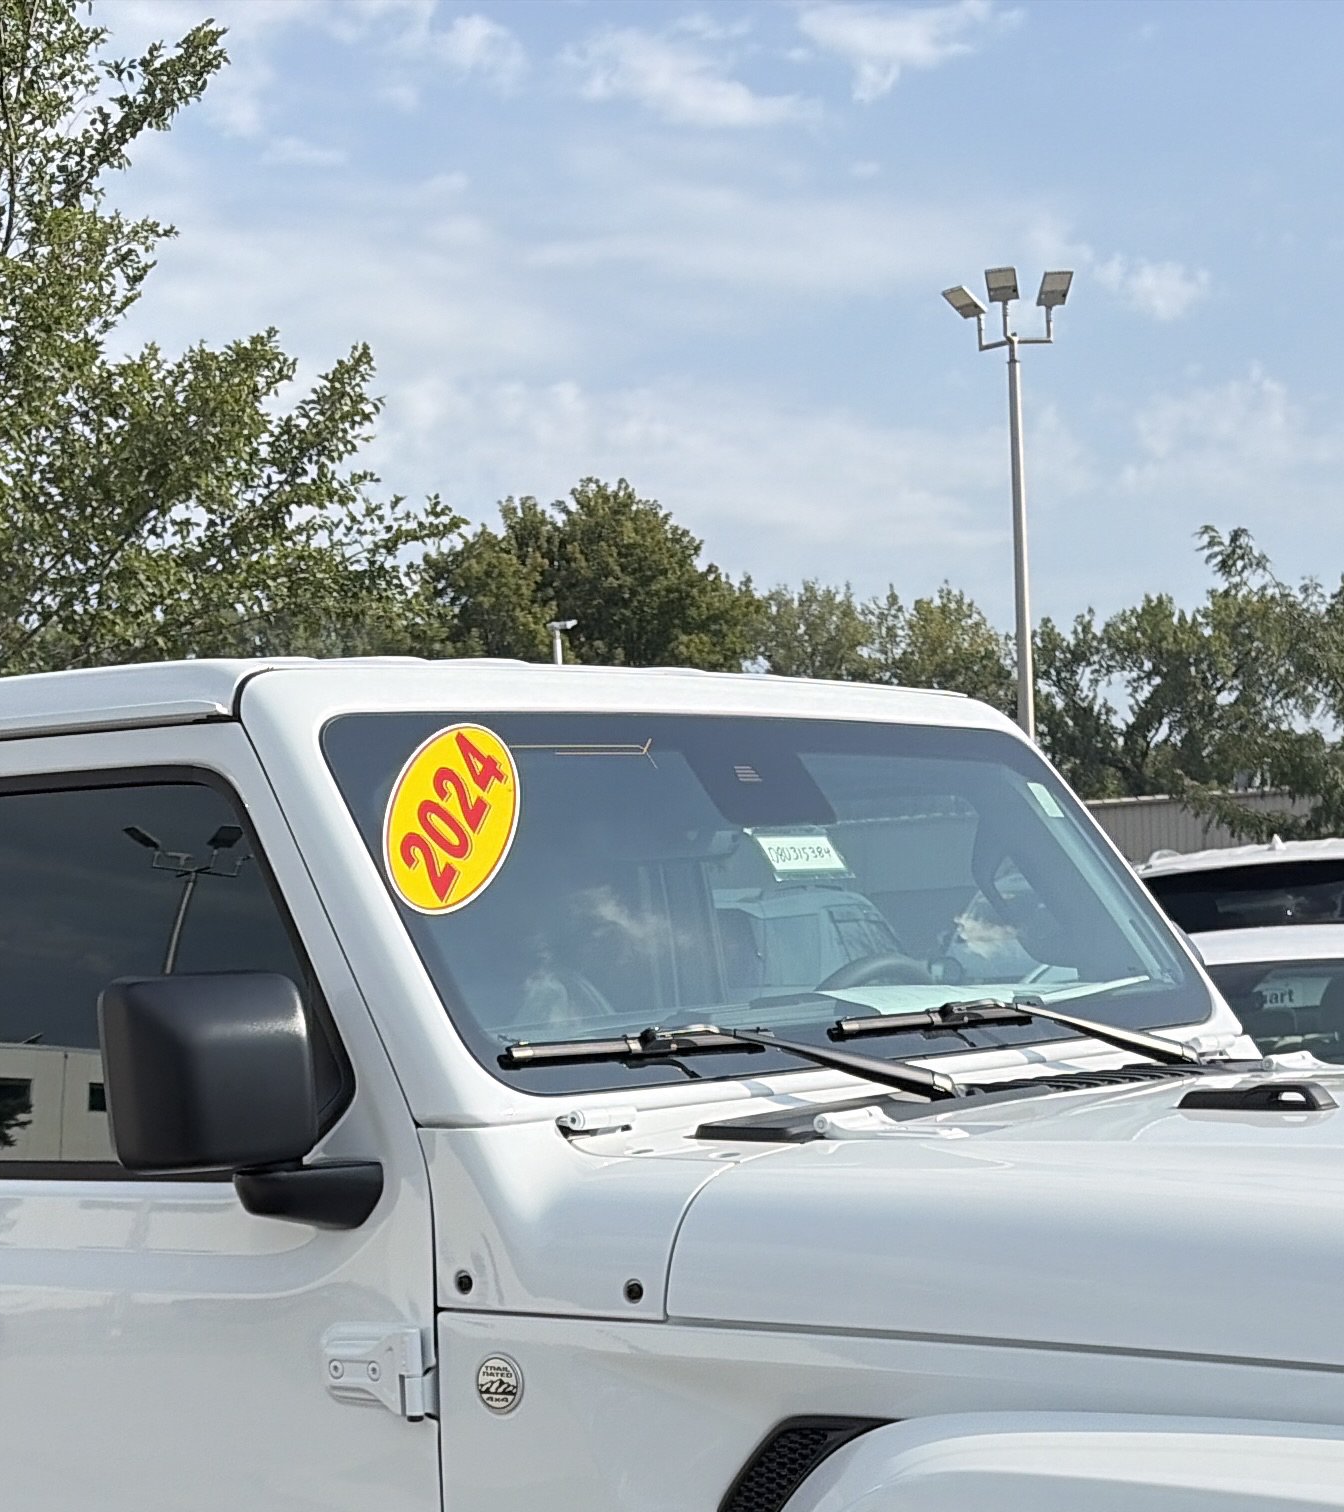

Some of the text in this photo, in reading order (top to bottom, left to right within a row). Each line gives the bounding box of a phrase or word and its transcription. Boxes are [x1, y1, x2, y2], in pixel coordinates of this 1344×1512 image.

[400, 731, 506, 903] 2024
[484, 1365, 511, 1373] TRAIL
[482, 1371, 513, 1379] RATED
